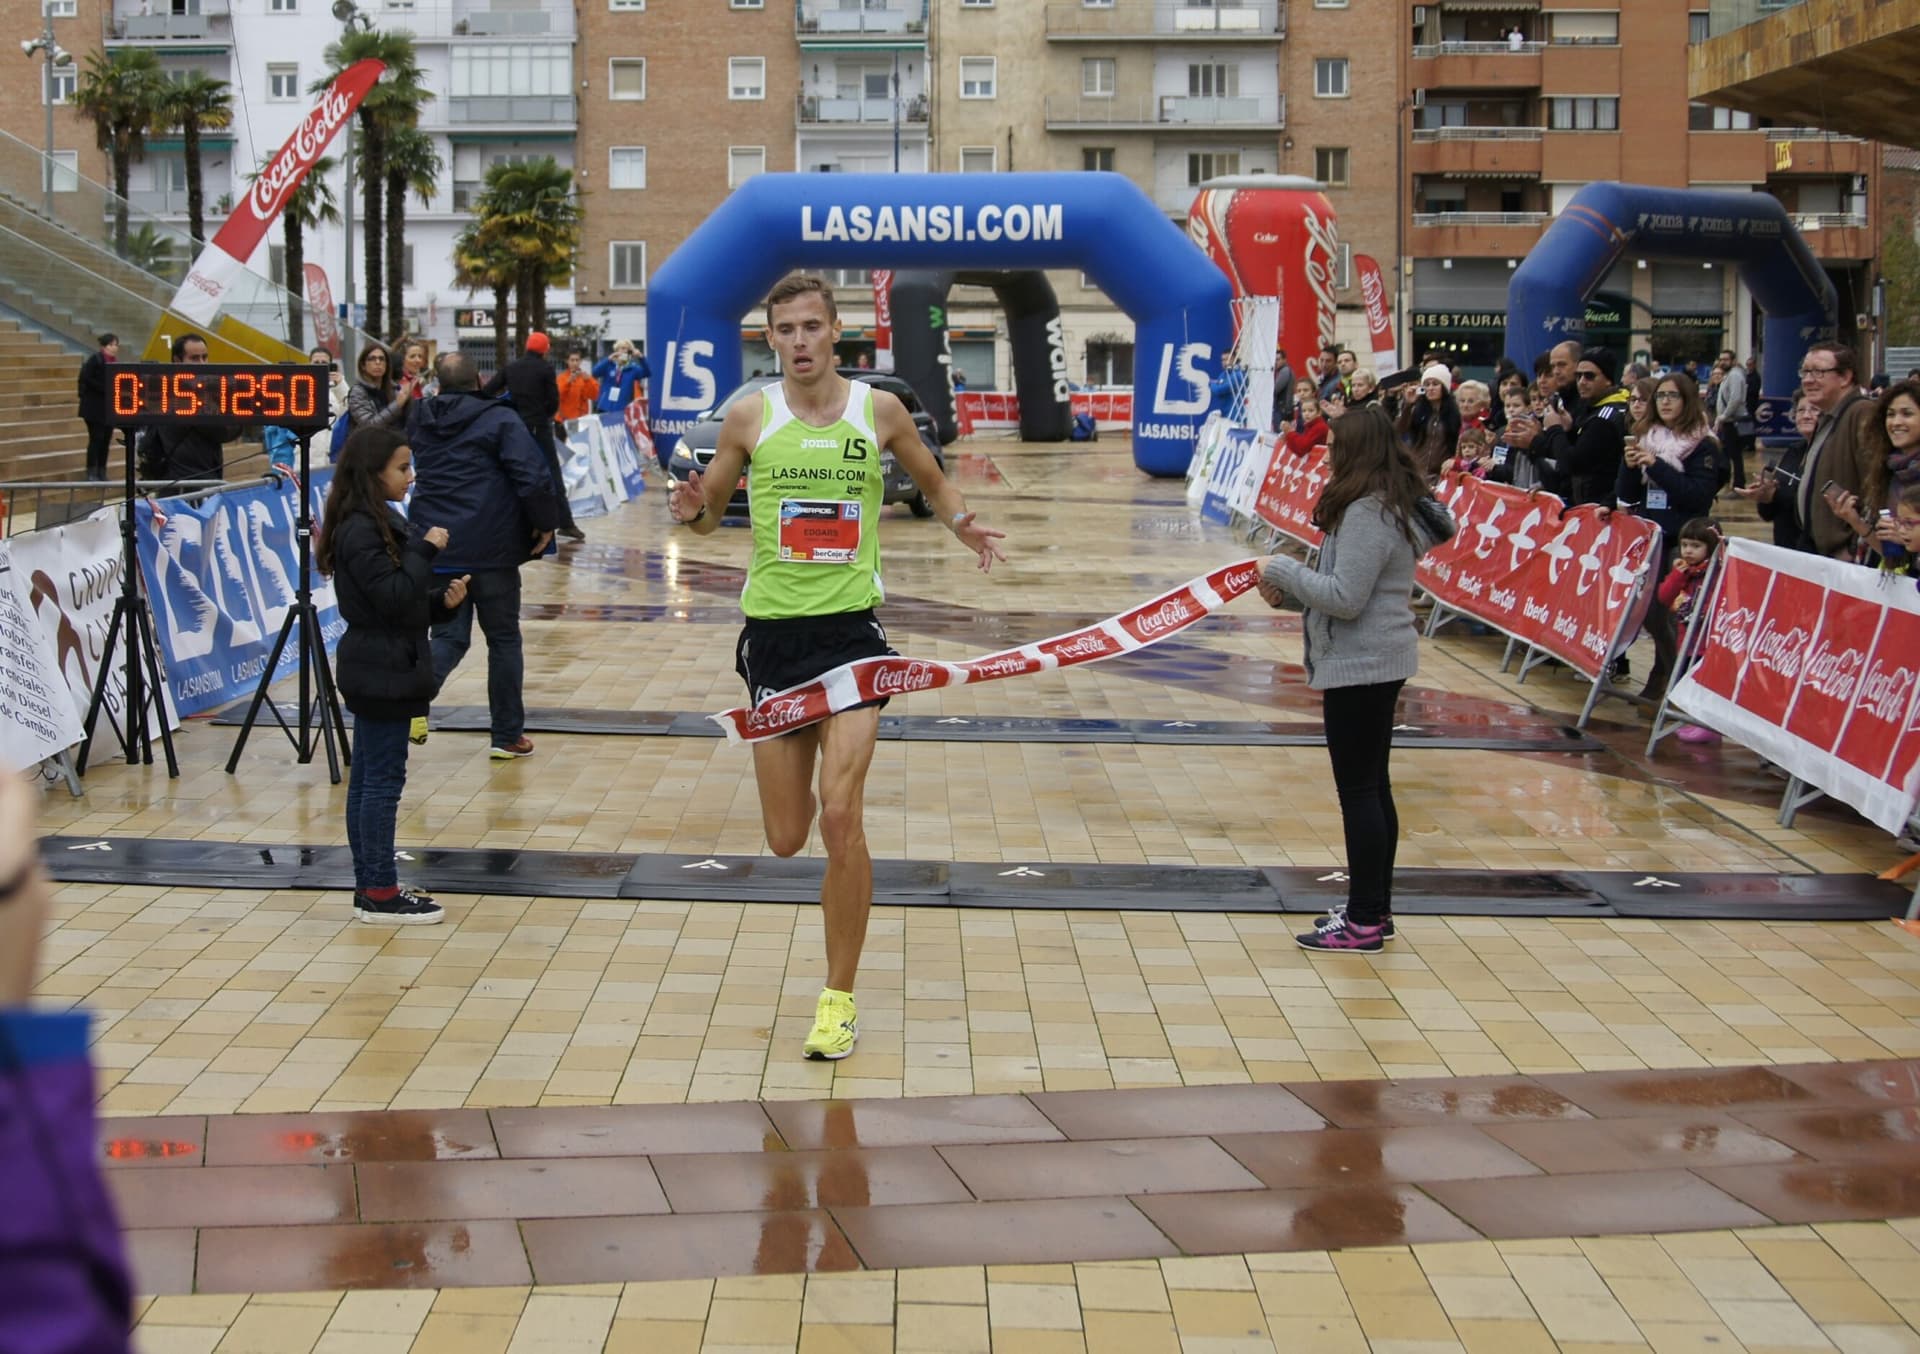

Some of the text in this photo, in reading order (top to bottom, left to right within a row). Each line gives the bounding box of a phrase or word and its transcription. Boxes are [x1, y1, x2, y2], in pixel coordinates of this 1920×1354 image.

[801, 204, 1063, 242] LASANSI.COM
[1253, 232, 1279, 243] Coke
[661, 340, 717, 411] LS
[1153, 342, 1212, 415] LS
[114, 372, 316, 417] 0:15:12:50
[651, 418, 700, 435] LASANS
[1138, 421, 1201, 440] LASANSI.
[842, 438, 868, 461] LS
[772, 468, 866, 481] LASANSI.COM
[814, 550, 843, 560] berCaja
[873, 661, 933, 696] Coca-Cola
[18, 692, 52, 719] Diesel
[15, 711, 57, 741] Cambio
